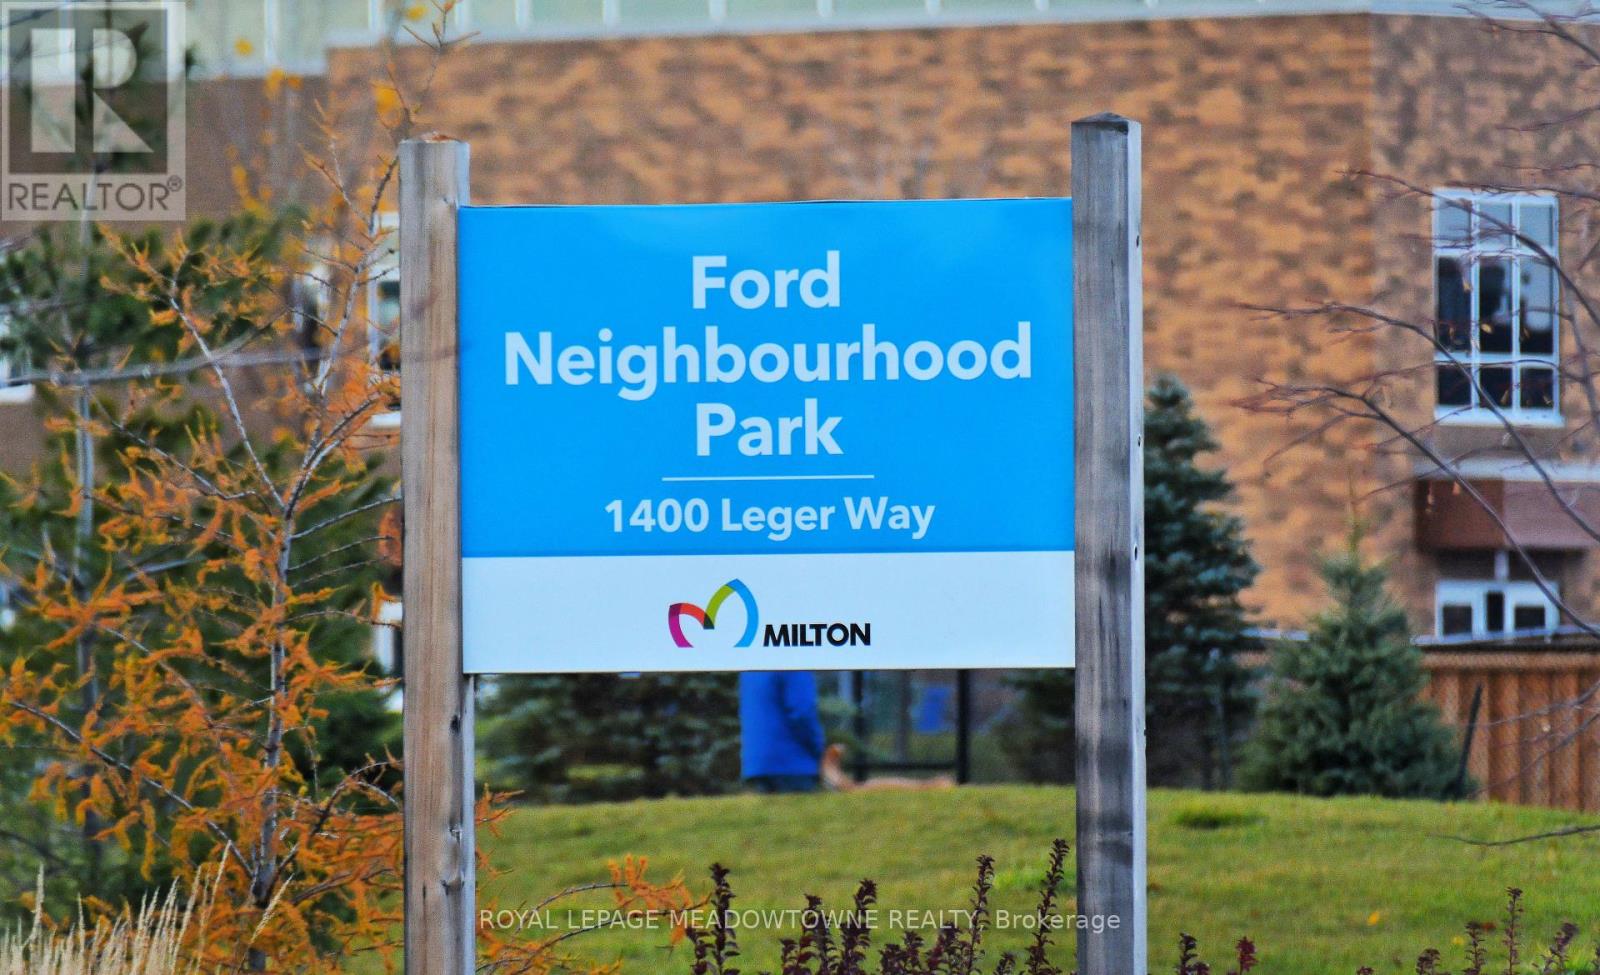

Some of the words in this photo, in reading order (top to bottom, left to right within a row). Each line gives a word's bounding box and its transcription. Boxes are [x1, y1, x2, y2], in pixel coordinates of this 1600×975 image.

[692, 250, 840, 310] Ford
[505, 321, 1032, 402] Neighbourhood
[696, 398, 843, 457] Park
[606, 498, 709, 533] 1400
[721, 497, 835, 542] Leger
[844, 496, 936, 541] Way
[763, 623, 871, 647] MILTON
